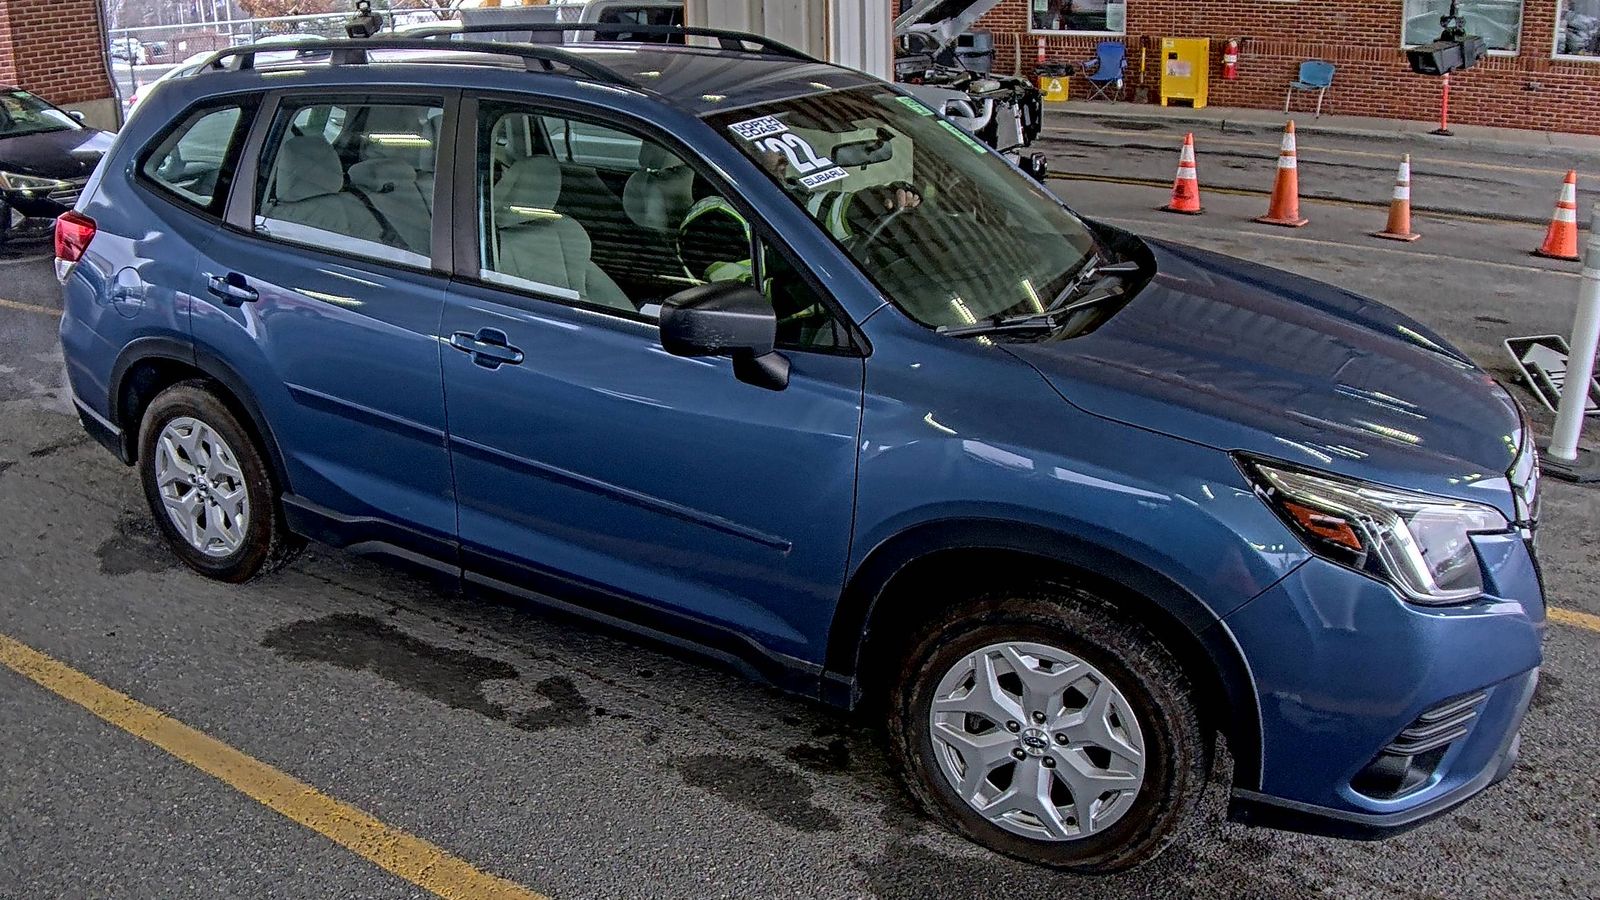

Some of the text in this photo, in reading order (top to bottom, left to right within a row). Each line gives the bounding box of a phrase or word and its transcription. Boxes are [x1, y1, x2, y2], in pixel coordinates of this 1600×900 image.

[732, 116, 777, 131] NORTH
[741, 123, 783, 138] COAST
[803, 169, 846, 187] SUBARU
